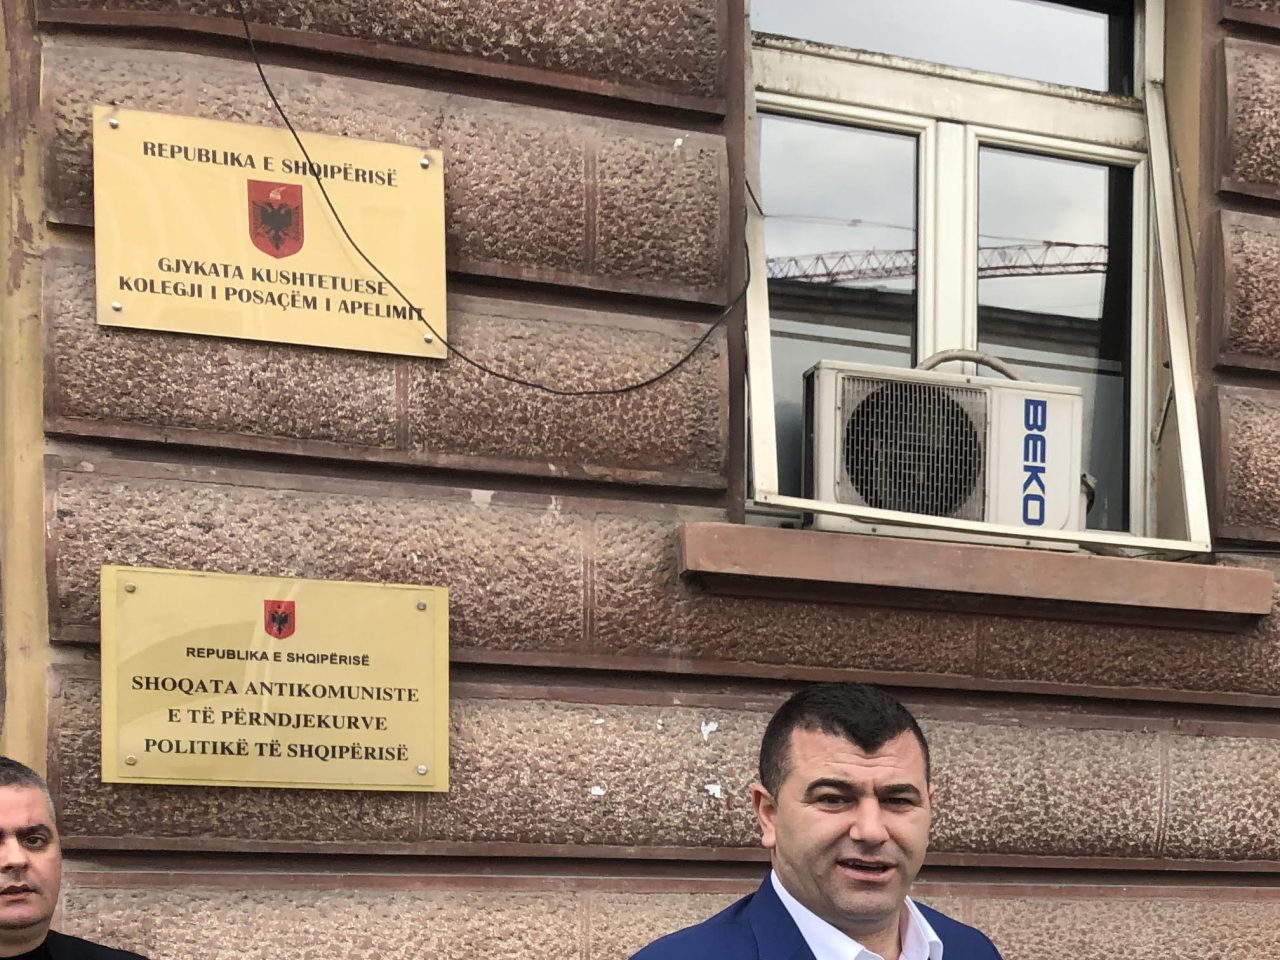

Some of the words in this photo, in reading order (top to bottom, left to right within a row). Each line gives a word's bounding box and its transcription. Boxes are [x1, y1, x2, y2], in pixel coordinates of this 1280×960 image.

[142, 141, 256, 170] REPUBLIKA
[263, 156, 274, 172] E
[281, 158, 399, 188] SHQIPËRISË
[158, 257, 244, 280] GJYKATA
[251, 267, 389, 297] KUSHTETUESE
[119, 276, 203, 299] KOLEGJI
[211, 285, 216, 300] I
[225, 287, 317, 311] POSAÇËM
[325, 297, 330, 312] I
[337, 300, 425, 322] APELIMIT
[1023, 398, 1047, 527] BEKO
[186, 647, 269, 661] REPUBLIKA
[273, 651, 282, 662] E
[286, 652, 370, 666] SHQIPËRISË
[131, 675, 238, 695] SHOQATA
[244, 681, 419, 702] ANTIKOMUNISTE
[167, 708, 181, 723] E
[187, 707, 215, 724] TË
[221, 708, 388, 731] PËRNDJEKURVE
[144, 738, 249, 756] POLITIKË
[254, 740, 282, 757] TË
[287, 743, 409, 761] SHQIPËRISË
